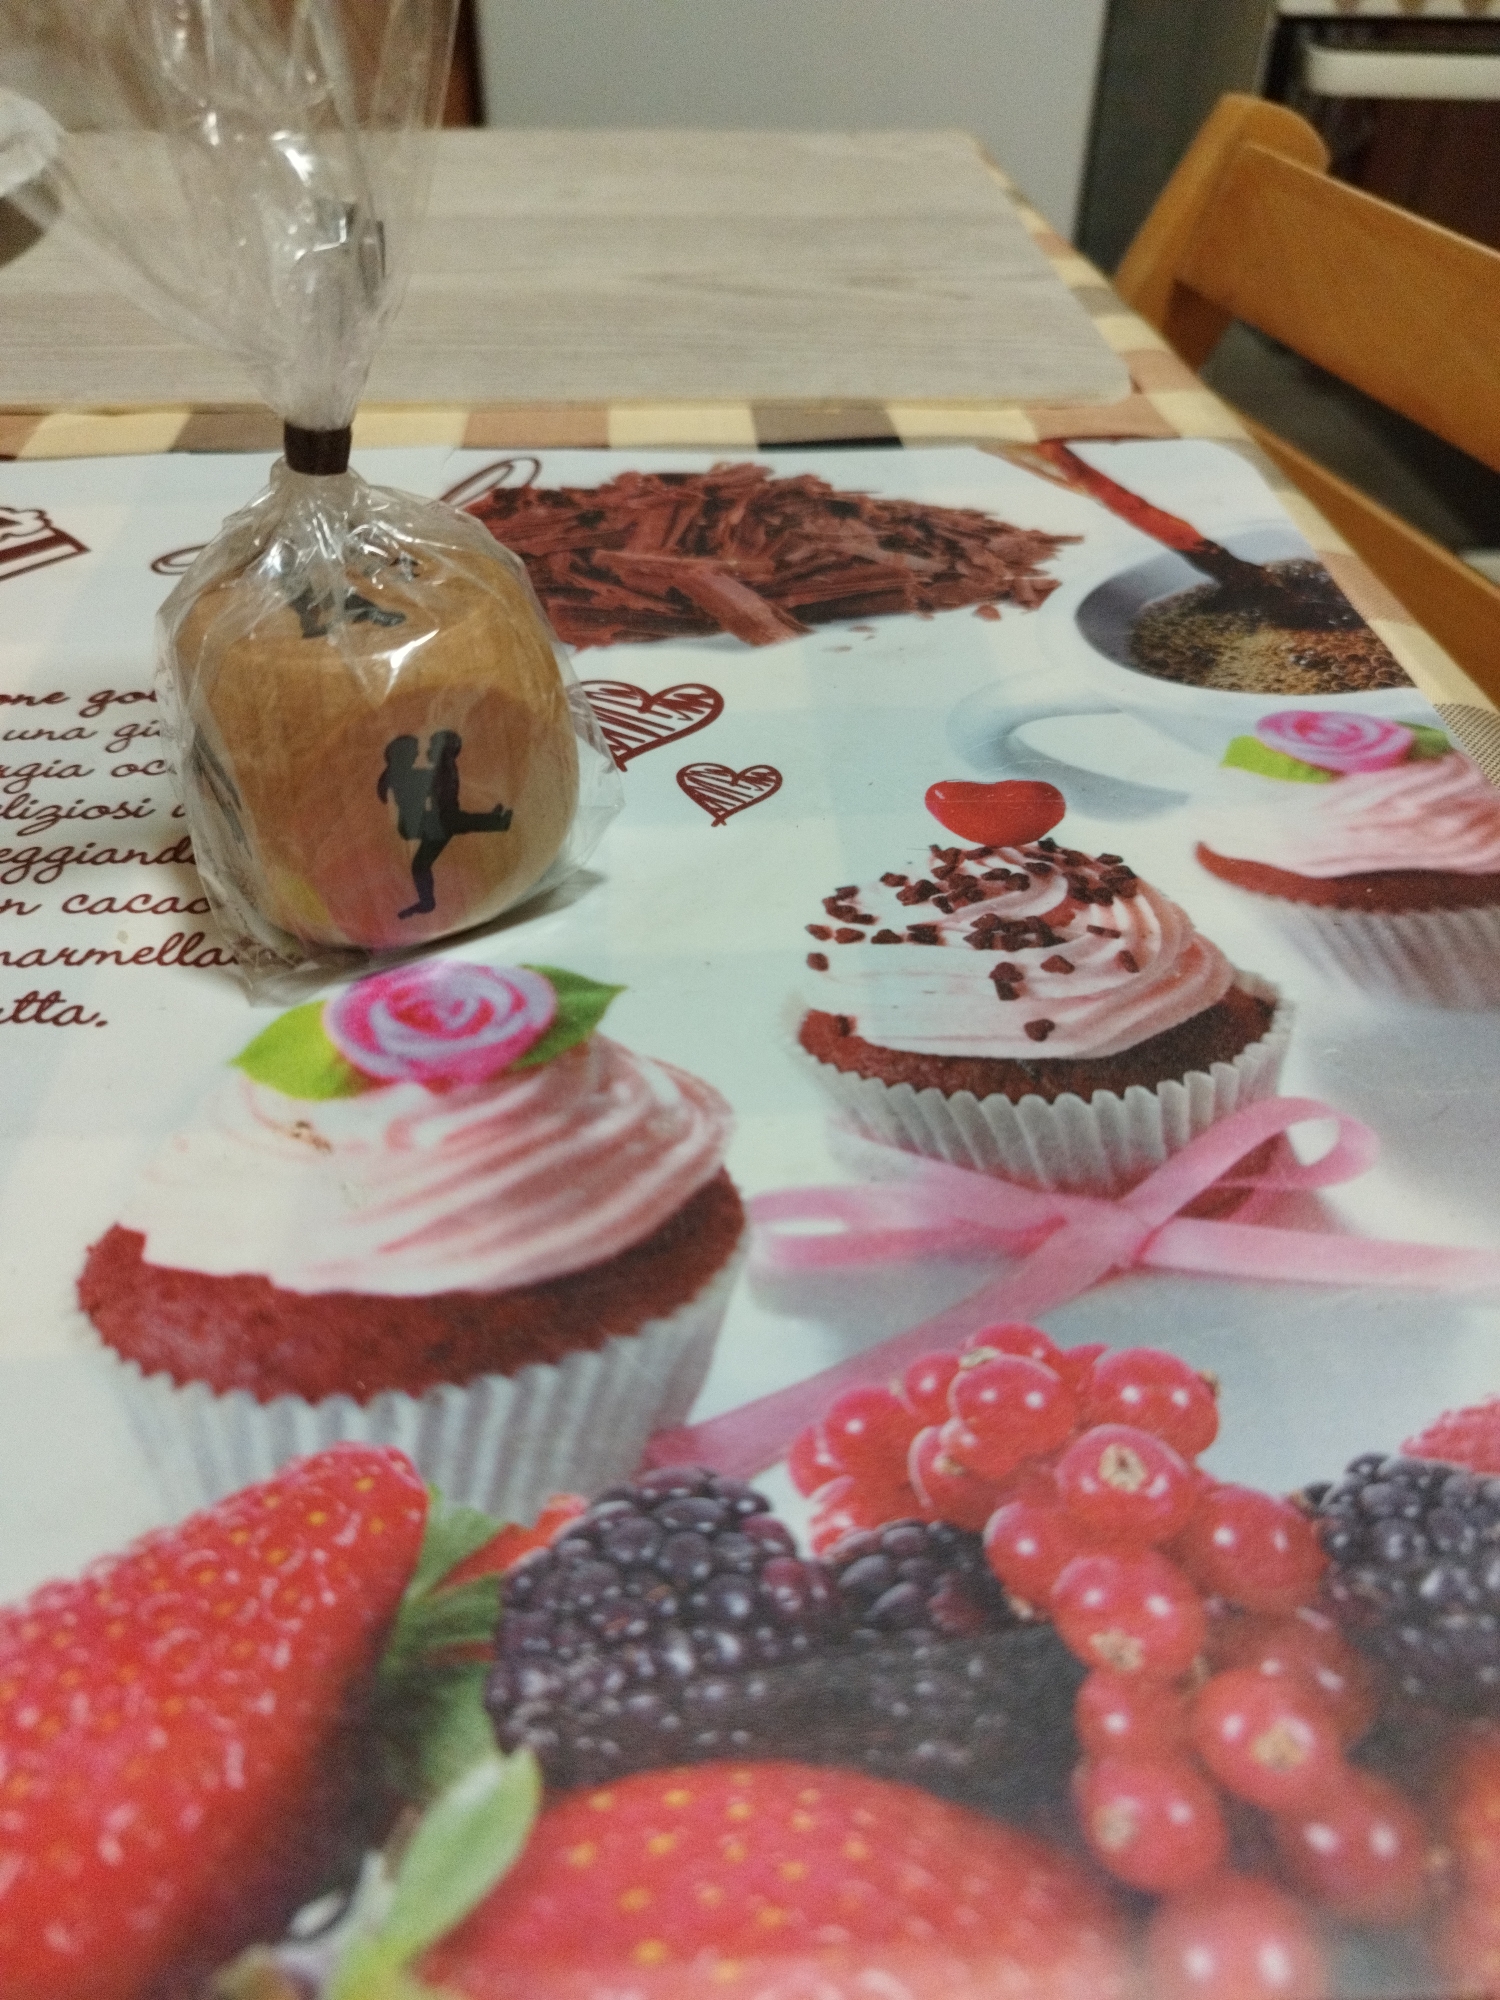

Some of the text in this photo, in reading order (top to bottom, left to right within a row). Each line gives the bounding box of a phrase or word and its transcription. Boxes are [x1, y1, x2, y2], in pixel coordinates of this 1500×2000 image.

[3, 720, 161, 753] una gi
[110, 759, 178, 778] oc
[0, 793, 156, 836] liziosi
[0, 836, 196, 884] eggiand
[0, 932, 239, 968] armella
[0, 990, 108, 1027] tta.
